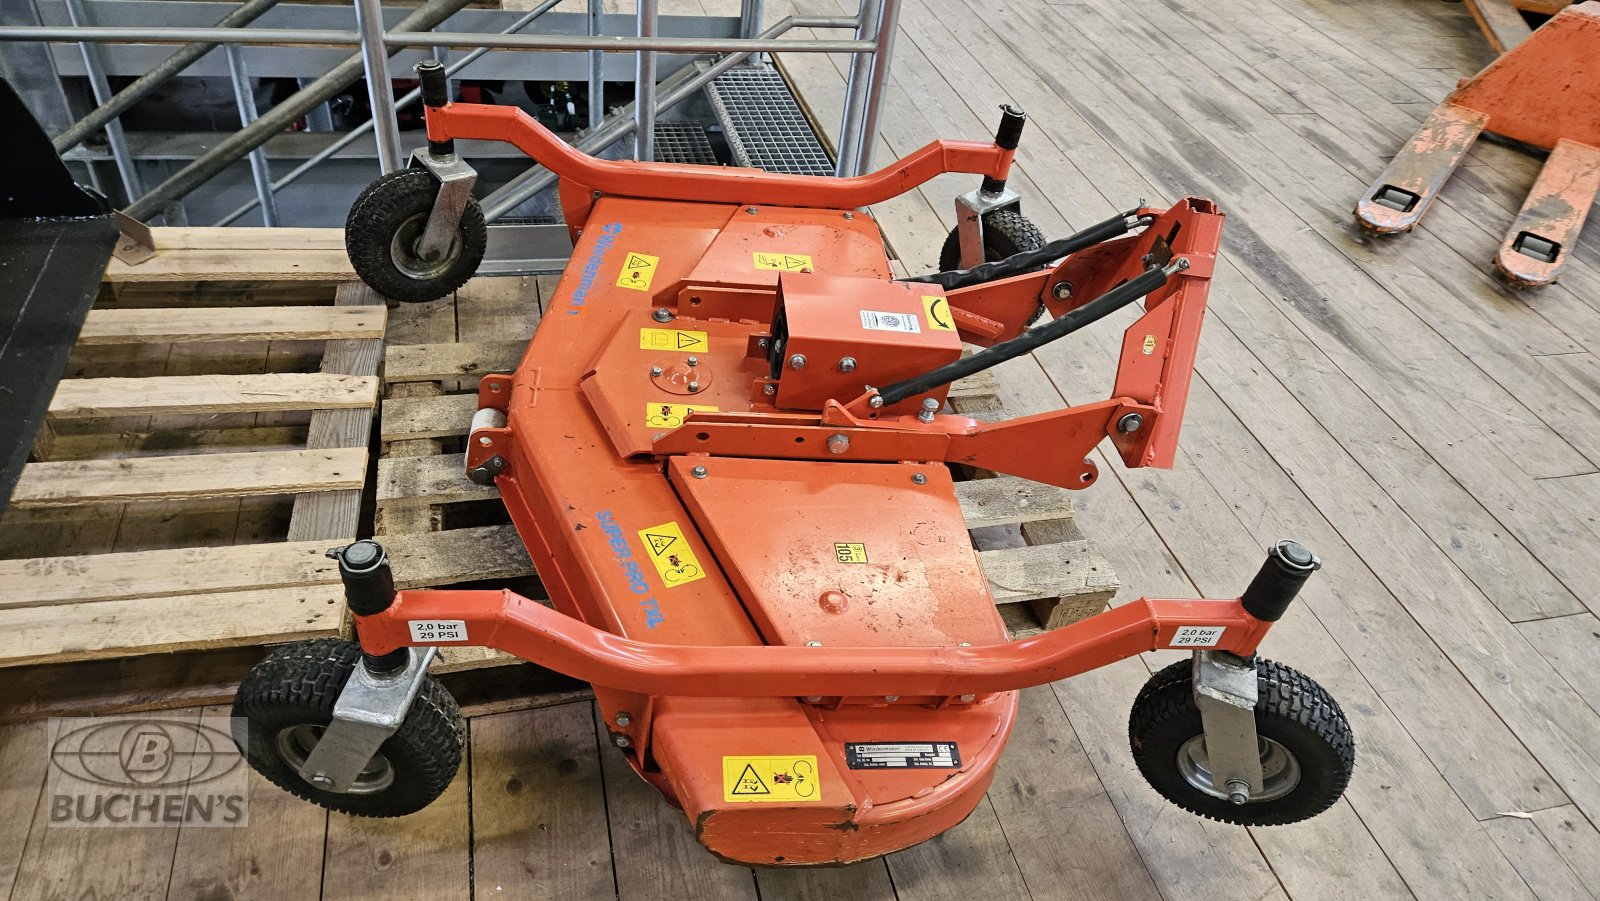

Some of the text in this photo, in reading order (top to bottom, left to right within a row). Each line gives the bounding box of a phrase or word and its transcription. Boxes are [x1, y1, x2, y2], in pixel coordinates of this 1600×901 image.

[837, 543, 853, 562] 105
[596, 511, 664, 629] SUPER PRO TXL
[416, 623, 434, 631] 2,0
[438, 631, 459, 639] PSI
